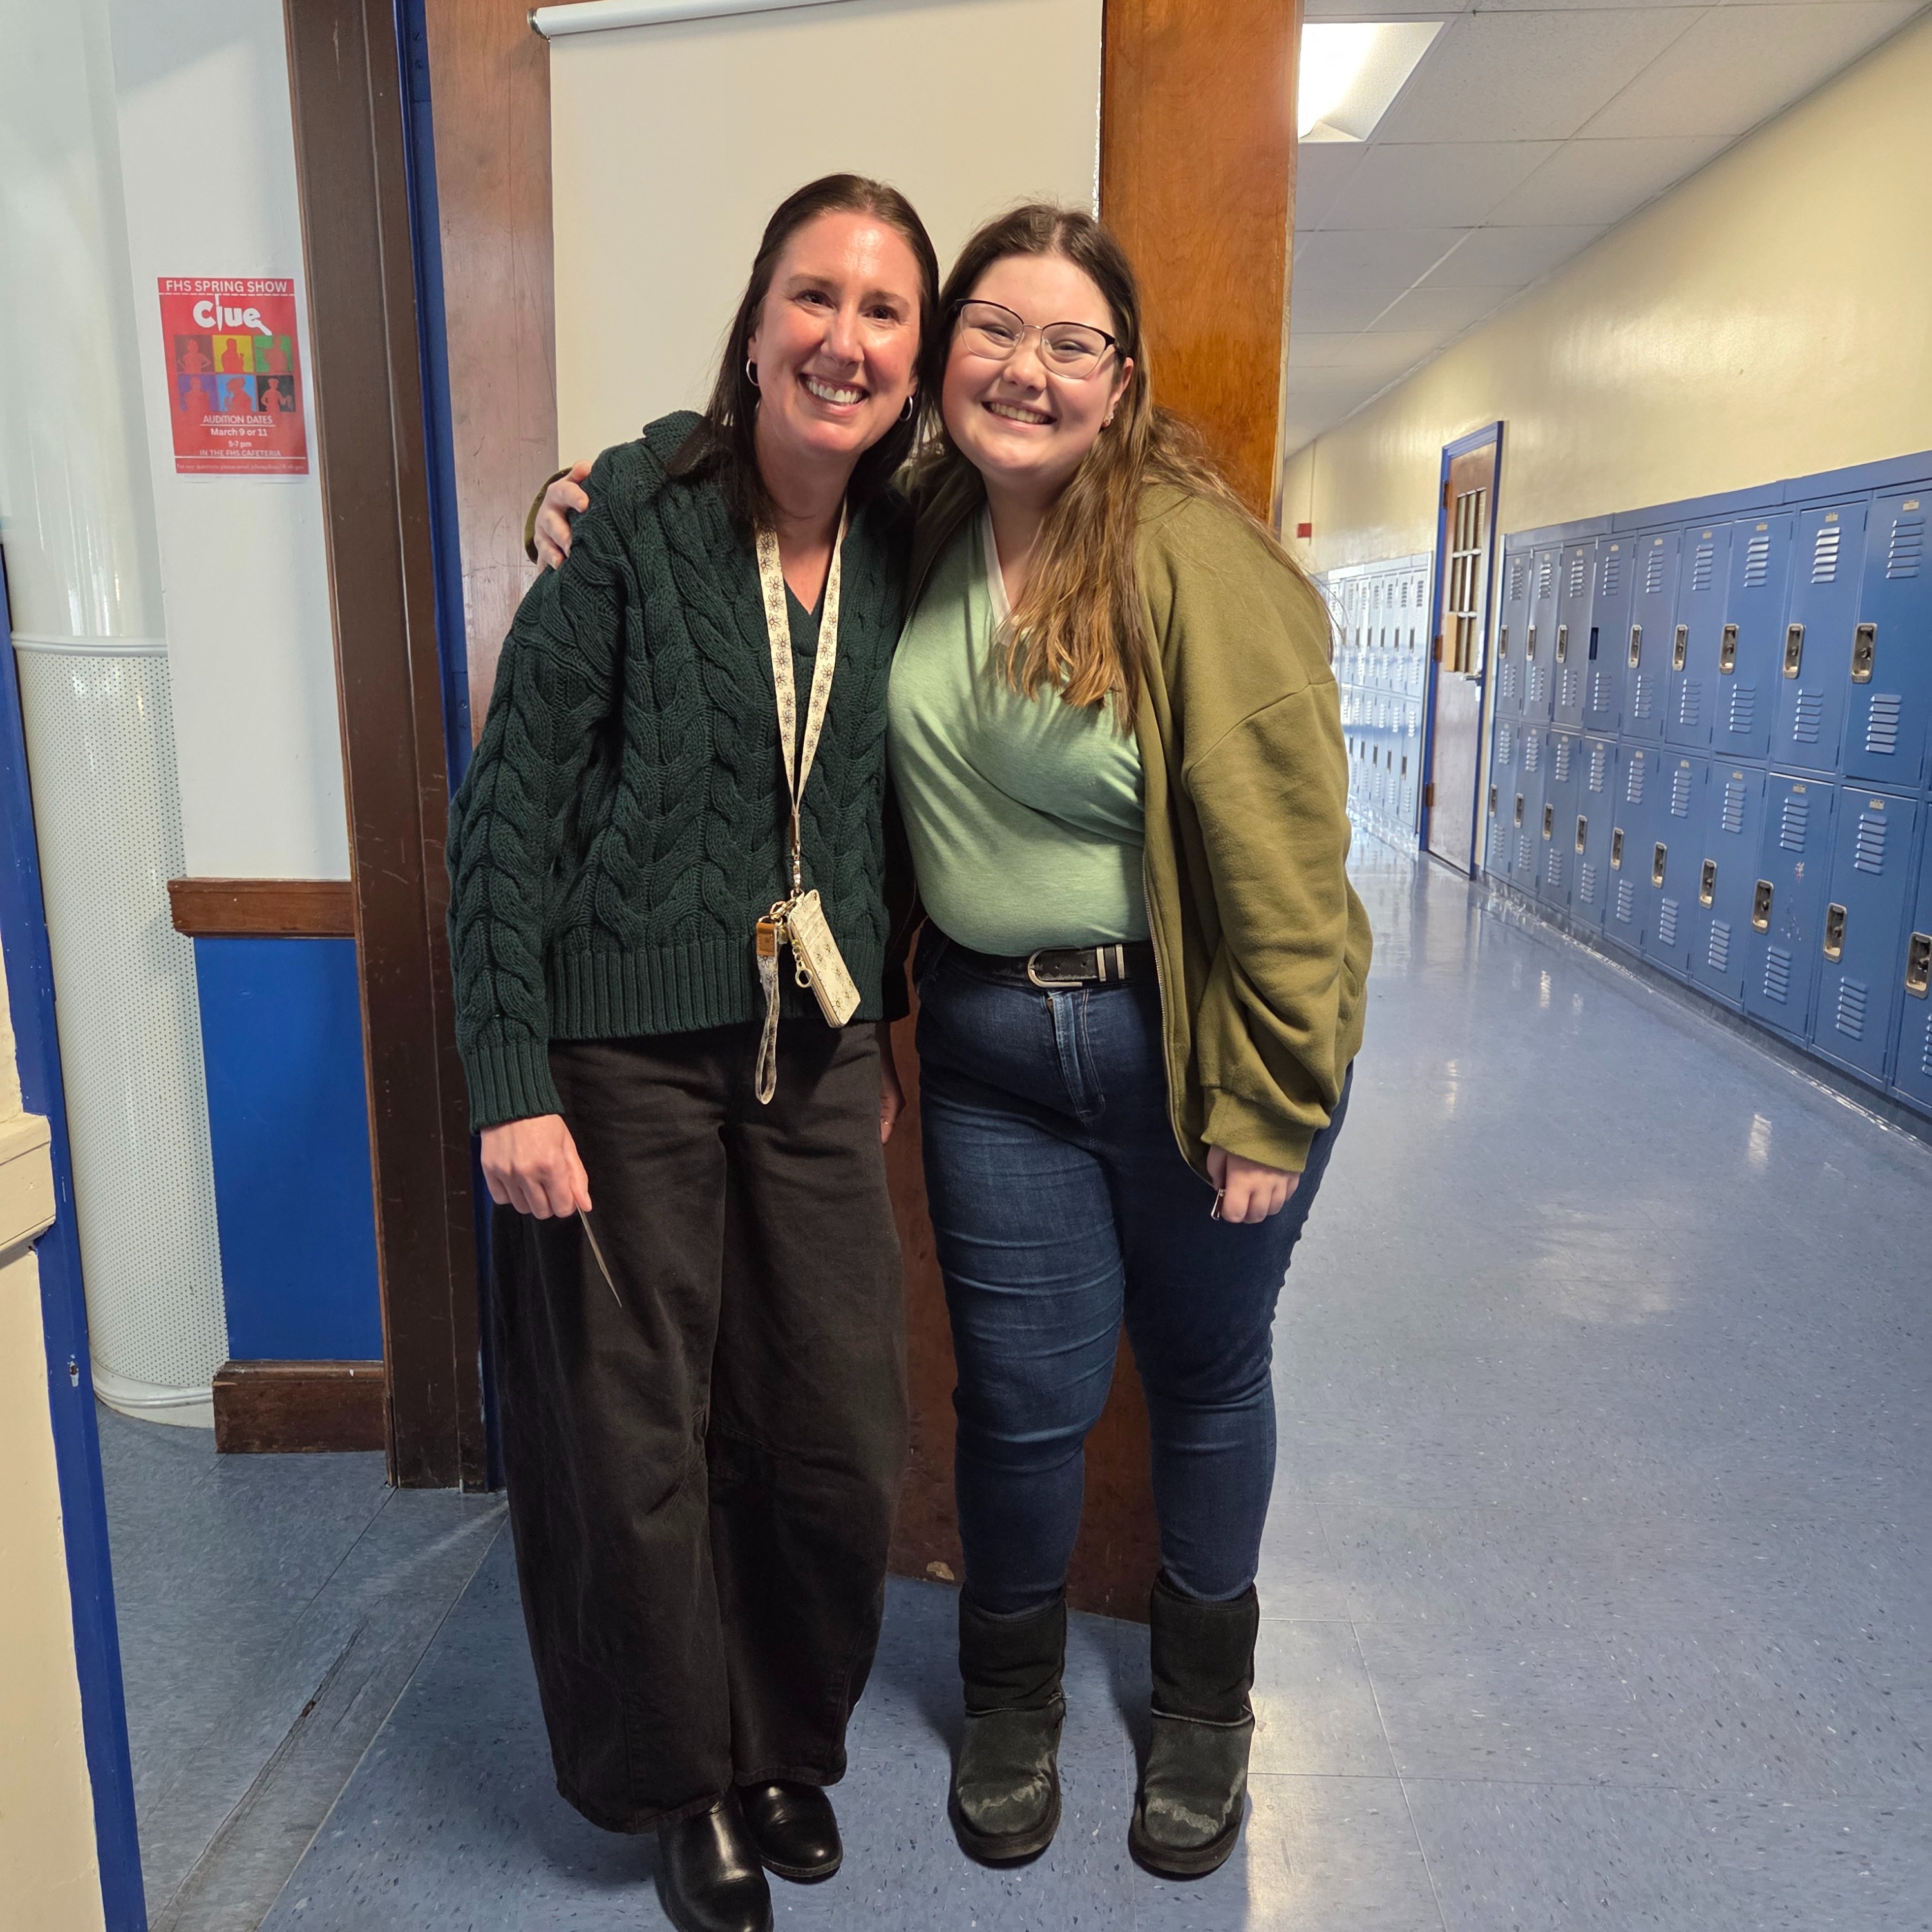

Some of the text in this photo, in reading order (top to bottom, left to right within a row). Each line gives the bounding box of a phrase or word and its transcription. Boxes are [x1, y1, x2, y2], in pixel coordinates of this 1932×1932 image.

[166, 280, 287, 292] FHS SPRING SHOW
[193, 294, 272, 336] Clue
[203, 415, 273, 424] AUDITION DATES
[211, 428, 238, 436] March
[258, 428, 268, 437] 11
